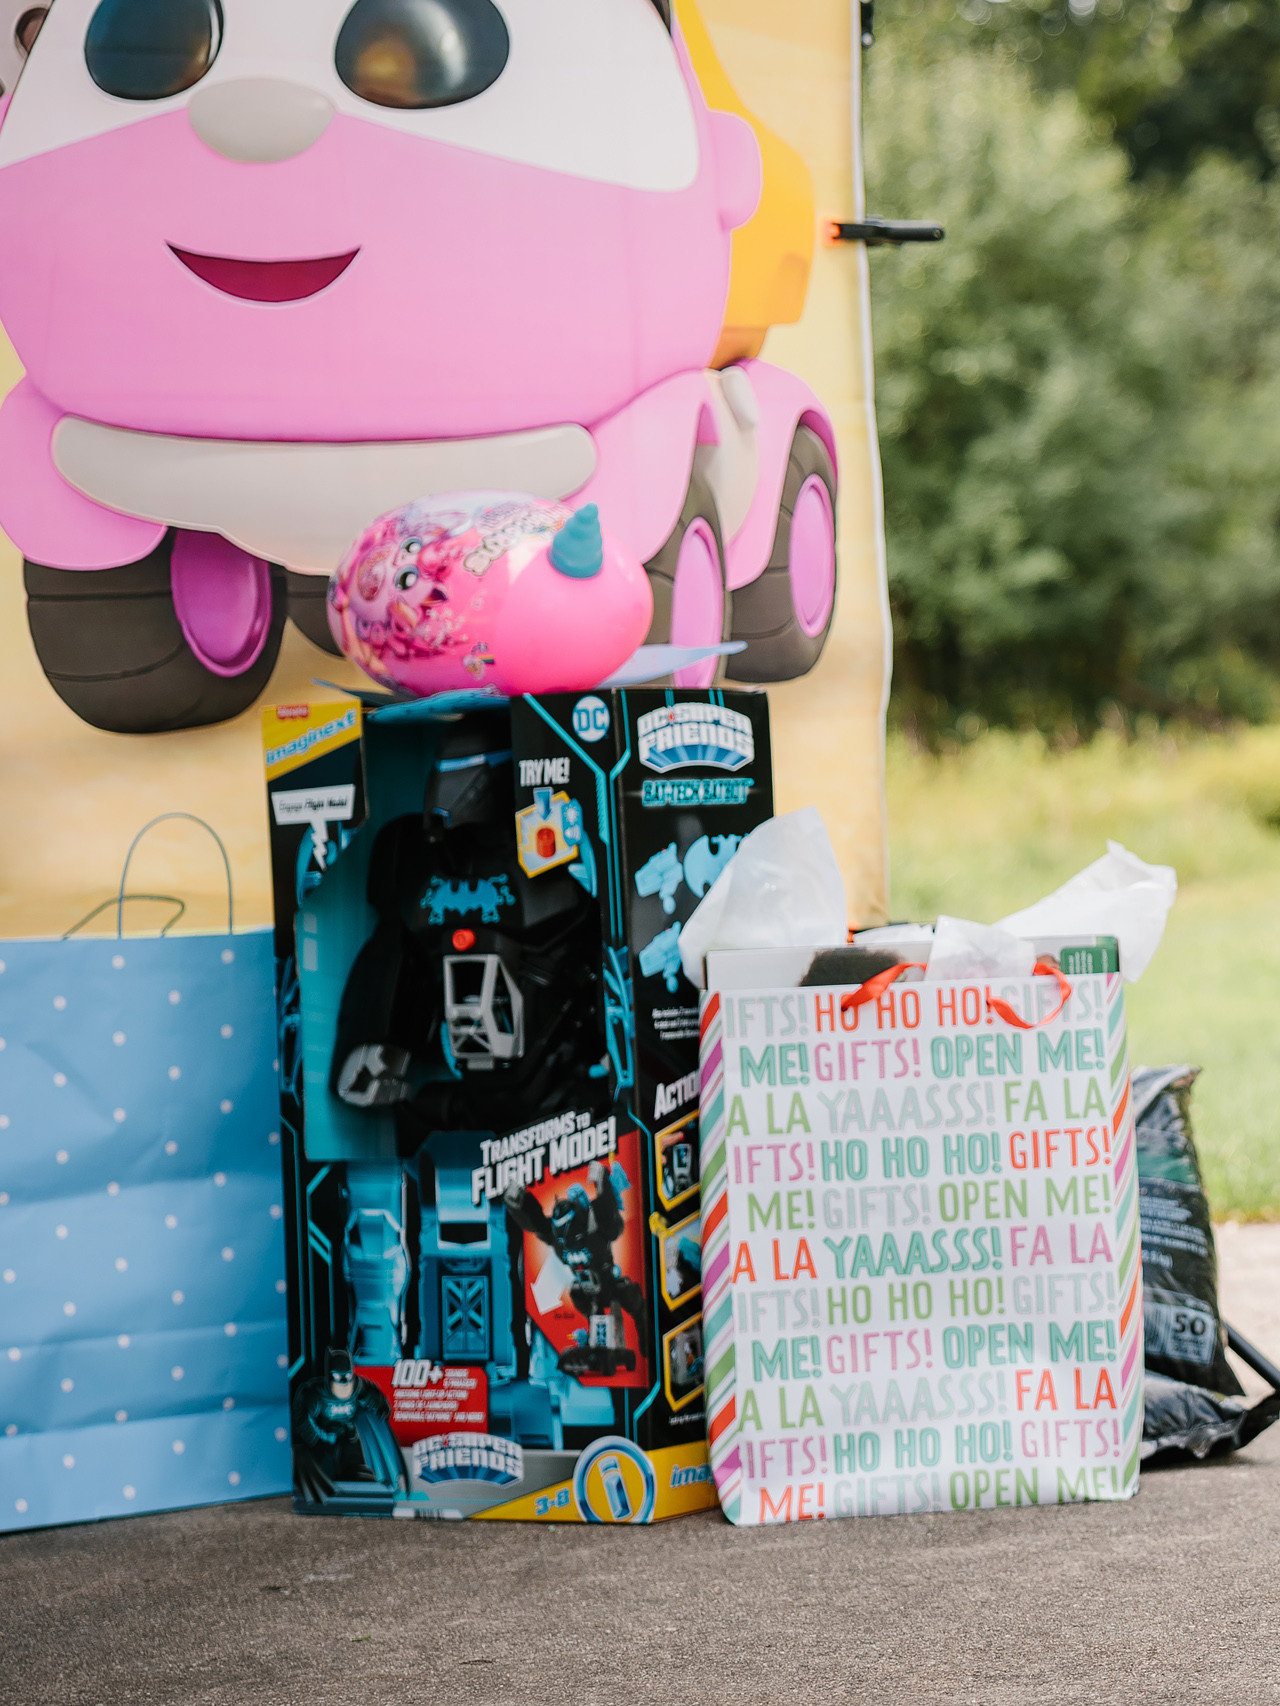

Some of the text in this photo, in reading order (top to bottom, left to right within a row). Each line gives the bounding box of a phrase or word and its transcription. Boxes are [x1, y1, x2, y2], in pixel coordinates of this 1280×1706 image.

[266, 709, 356, 766] imaginext
[576, 709, 608, 733] DC
[638, 721, 755, 761] FRIENDS
[519, 757, 571, 788] TRY ME!
[726, 994, 809, 1037] IFTS!
[876, 989, 920, 1029] HO
[937, 986, 993, 1026] HO!
[740, 1028, 1105, 1086] ME! GIFTS! OPEN ME!
[726, 1076, 1107, 1136] A LA YAAASSS! FA LA
[471, 1115, 618, 1206] FLIGHT MODE!
[480, 1111, 576, 1167] TRANSFORMS
[733, 1126, 1113, 1183] IFTS! HO HO HO! GIFTS!
[747, 1174, 1111, 1232] ME! GIFTS! OPEN ME!
[732, 1241, 756, 1283] A
[773, 1239, 817, 1280] LA
[824, 1227, 1002, 1279] YAAASSS!
[1011, 1225, 1053, 1267] FA
[1070, 1222, 1113, 1263] LA
[738, 1271, 1115, 1332] IFTS! HO HO HO! GIFTS!
[1174, 1312, 1206, 1337] 50
[391, 1359, 443, 1389] 100+
[752, 1319, 1116, 1382] ME! GIFTS! OPEN ME!
[738, 1367, 1117, 1430] A LA YAAASSS! FA LA
[413, 1448, 524, 1481] FRIENDS
[746, 1418, 1120, 1478] IFTS! HO HO HO! GIFTS!
[535, 1488, 570, 1516] 3-8
[759, 1483, 825, 1523] ME!
[949, 1468, 1039, 1509] OPEN
